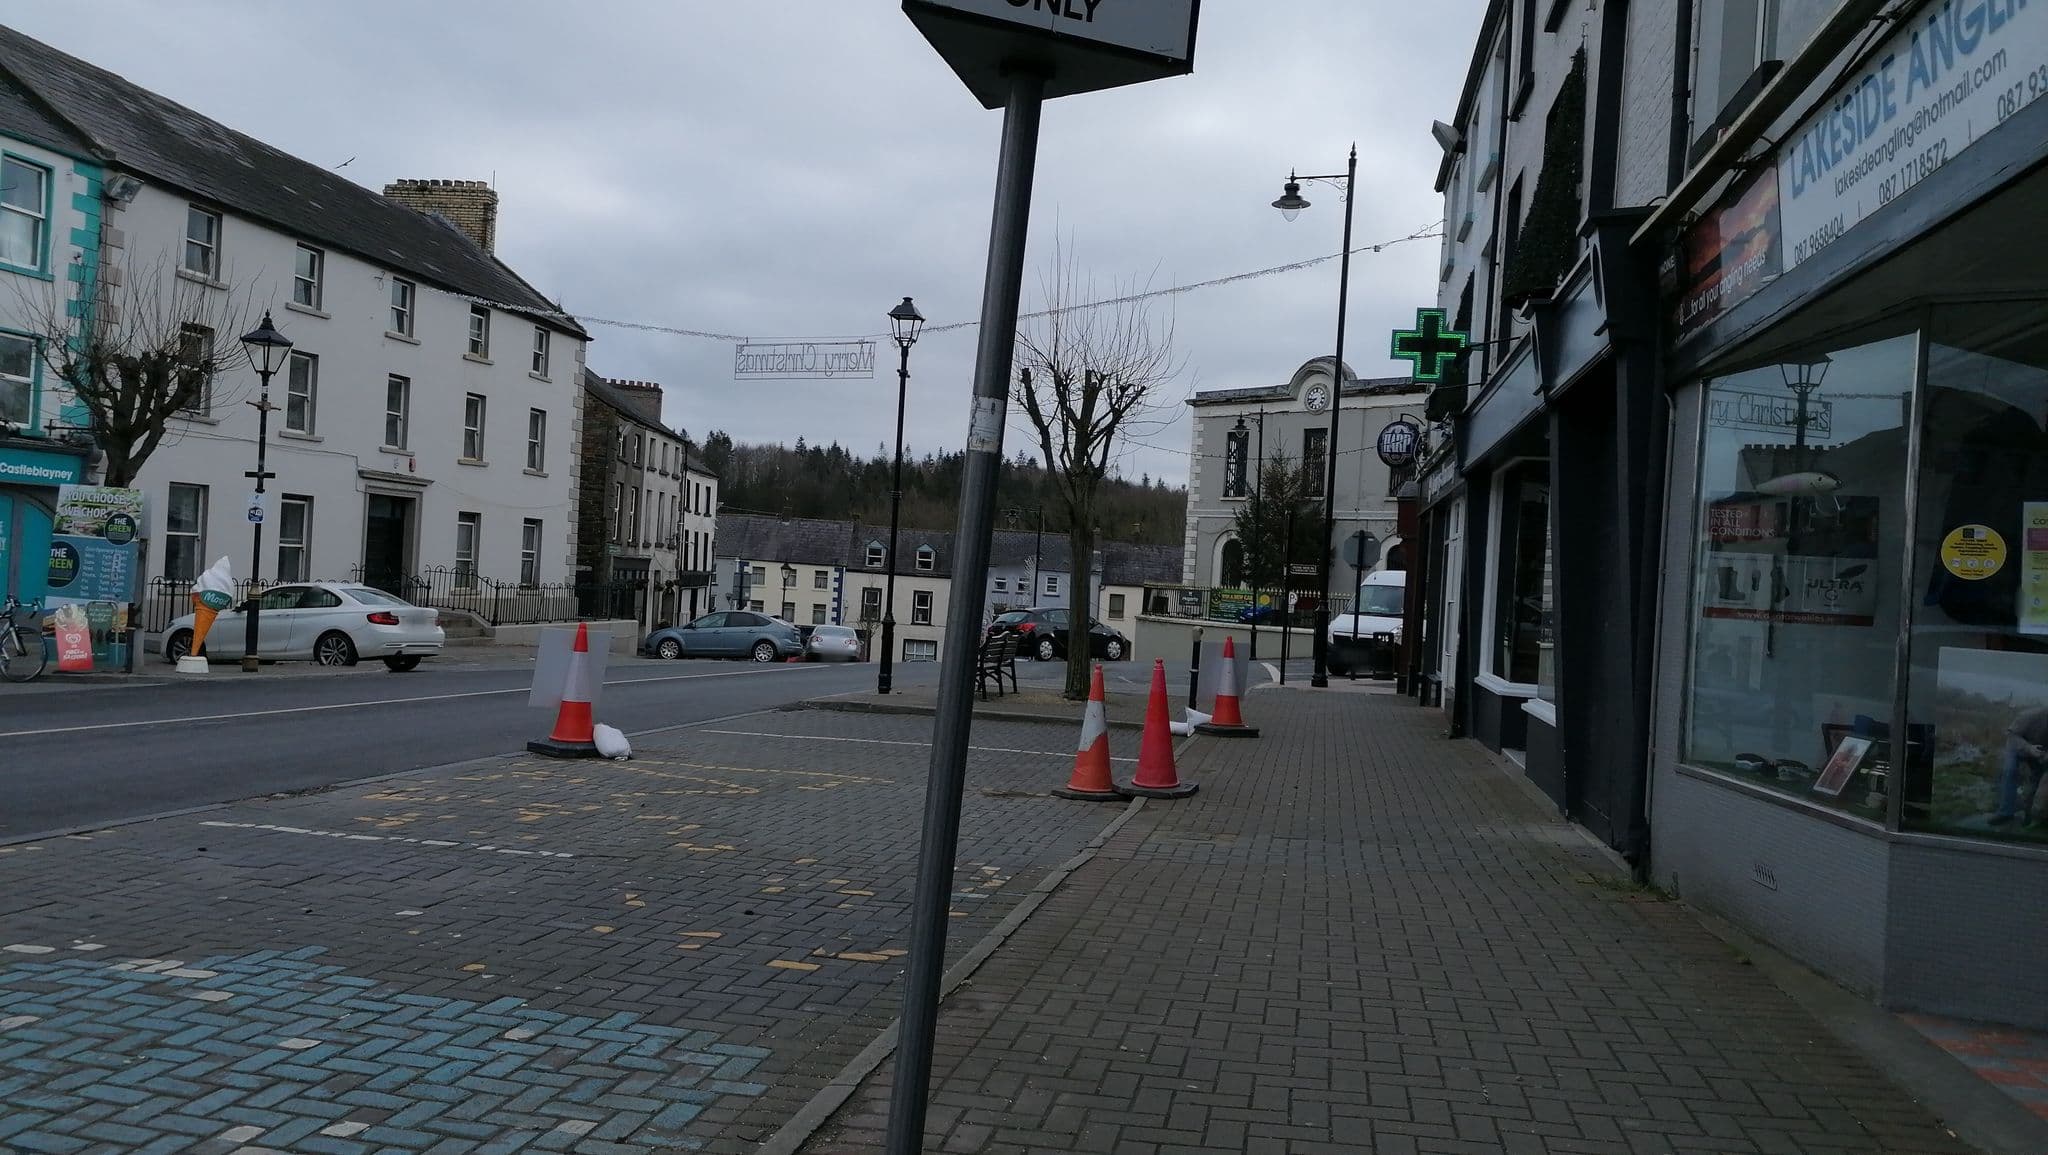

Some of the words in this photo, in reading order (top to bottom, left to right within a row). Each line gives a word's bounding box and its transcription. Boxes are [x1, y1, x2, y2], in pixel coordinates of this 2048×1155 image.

[1006, 0, 1101, 23] LY
[1790, 54, 1897, 199] LAKESIDE
[1905, 0, 2027, 104] ANGL
[1997, 82, 2024, 122] 087
[1834, 48, 2008, 198] lakesideangling@hotmail.com
[1878, 174, 1897, 205] 087
[1901, 138, 1950, 193] 1718572
[1794, 241, 1807, 265] 087
[1809, 213, 1844, 253] 9658404
[1706, 284, 1719, 310] your
[1720, 266, 1743, 295] angling
[1744, 248, 1766, 277] needs
[1383, 432, 1411, 453] HARP
[0, 462, 73, 480] Castleblayney
[67, 491, 87, 502] YOU
[1711, 509, 1743, 518] TESTED
[107, 525, 132, 533] GREEN
[113, 518, 127, 526] THE
[1711, 518, 1721, 527] IN
[1723, 518, 1741, 528] ALL
[1711, 527, 1777, 537] CONDITIONS
[50, 548, 68, 558] THE
[48, 558, 74, 569] REEN
[1808, 578, 1864, 593] ULTRA
